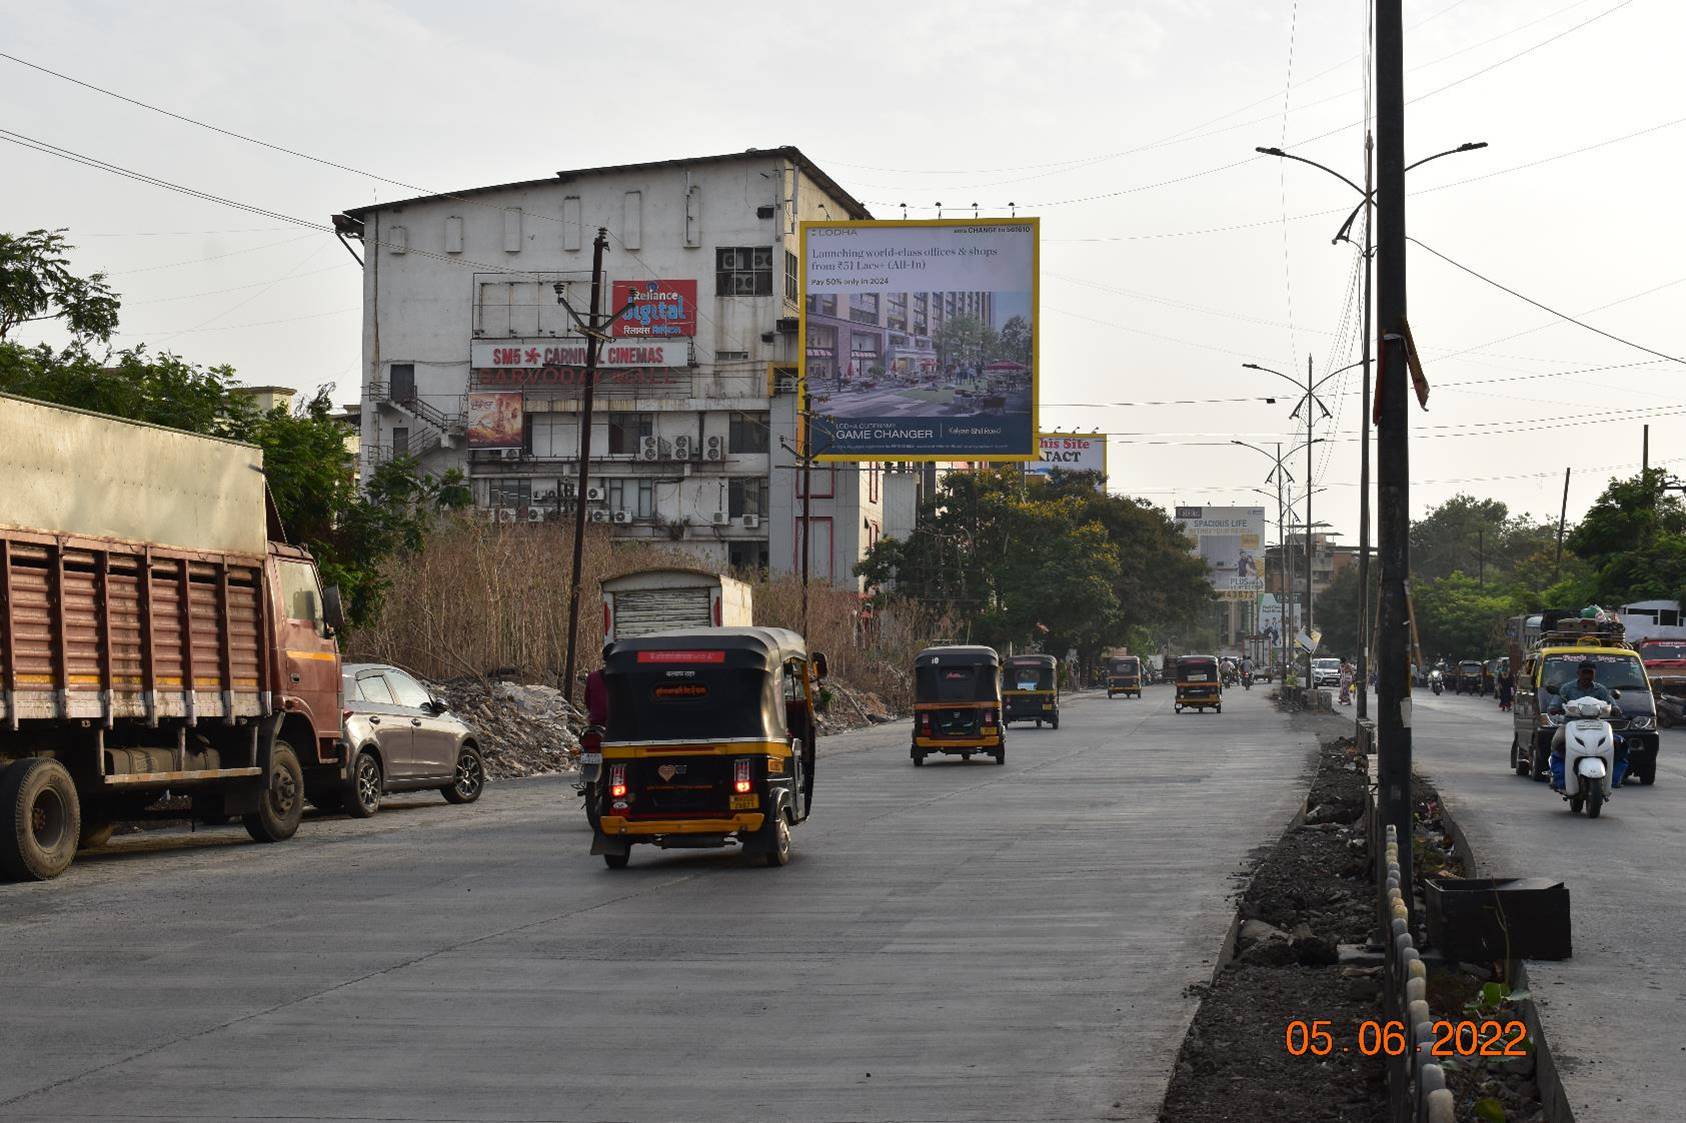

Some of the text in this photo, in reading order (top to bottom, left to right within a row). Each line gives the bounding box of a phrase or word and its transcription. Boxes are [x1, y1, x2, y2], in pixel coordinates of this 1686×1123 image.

[812, 247, 998, 260] Launching world-class offices & shops
[811, 260, 836, 271] from
[811, 278, 825, 288] Pay
[543, 347, 604, 365] CARNIVL
[607, 346, 664, 364] CINEMAS
[836, 429, 934, 440] GAME CHANGER
[1063, 438, 1090, 449] Site
[1193, 519, 1248, 528] SPACIOUS LIFE
